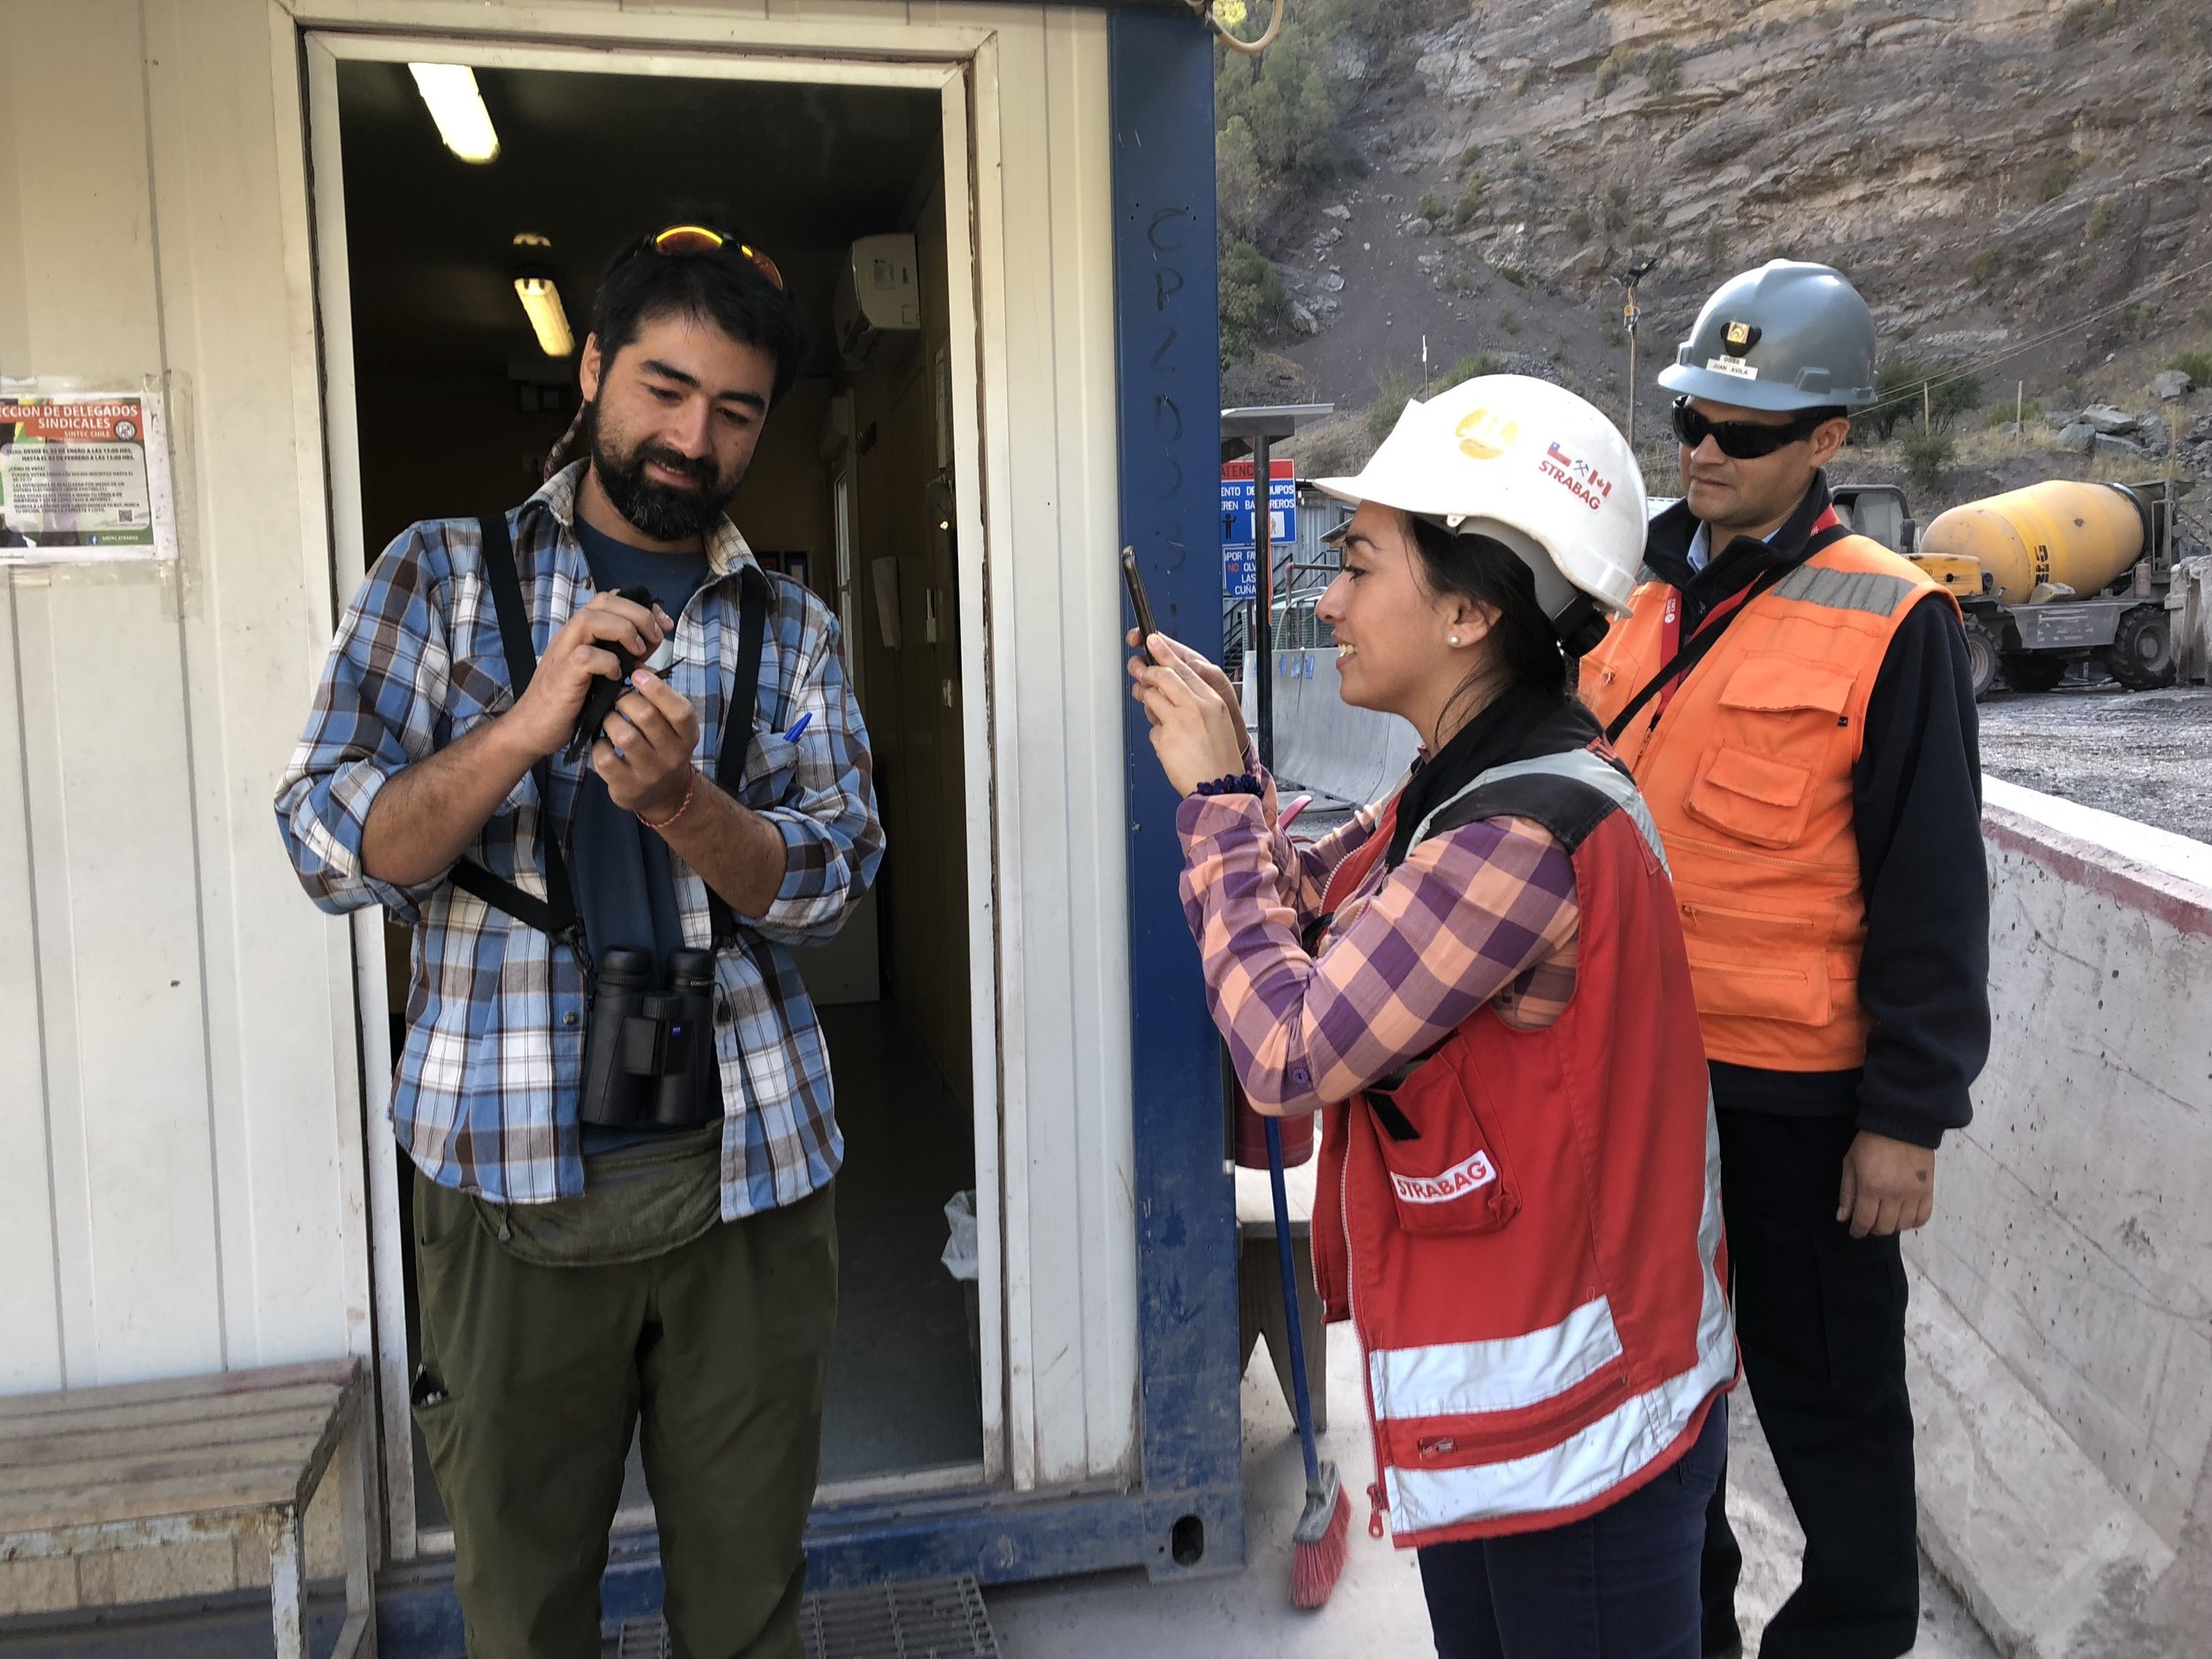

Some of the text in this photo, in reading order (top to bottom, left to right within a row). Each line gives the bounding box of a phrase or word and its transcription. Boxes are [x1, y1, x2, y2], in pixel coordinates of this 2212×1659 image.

[44, 406, 60, 417] DE
[64, 405, 138, 417] DELEGADOS
[38, 419, 111, 429] SINDICALES
[1539, 460, 1601, 510] STRABAG
[1228, 563, 1239, 572] NO
[1241, 573, 1256, 583] LAS
[1396, 1160, 1487, 1198] STRABAG
